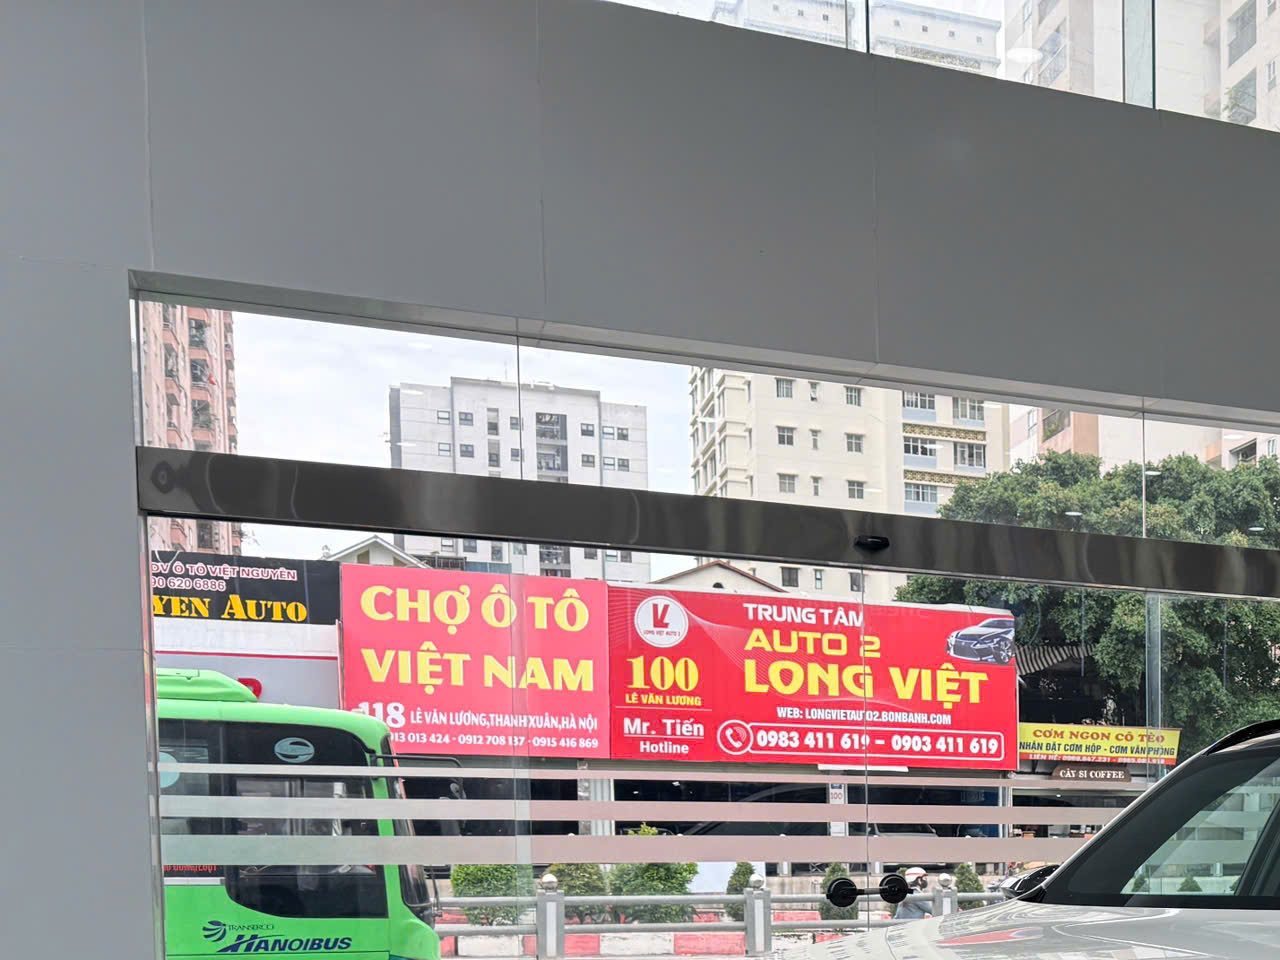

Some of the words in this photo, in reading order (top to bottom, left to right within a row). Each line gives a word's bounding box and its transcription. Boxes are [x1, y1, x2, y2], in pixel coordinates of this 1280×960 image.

[187, 562, 207, 577] TÔ
[207, 564, 239, 579] VIỆT
[167, 577, 194, 590] 620
[194, 579, 226, 591] 6886
[360, 585, 470, 635] CHỢ
[481, 583, 517, 628] Ô
[527, 588, 589, 632] TÔ
[743, 603, 816, 624] TRUNG
[819, 606, 864, 627] TÂM
[743, 628, 848, 656] AUTO
[859, 635, 881, 659] 2
[360, 641, 471, 695] VIỆT
[483, 655, 594, 692] NAM
[626, 655, 699, 691] 100
[744, 658, 874, 699] LONG
[888, 663, 989, 709] VIỆT
[625, 693, 638, 704] LÊ
[641, 693, 663, 705] VĂN
[410, 707, 422, 724] LÊ
[424, 708, 448, 724] VĂN
[579, 714, 597, 733] NỘI
[776, 706, 803, 719] WEB:
[623, 717, 656, 735] Mr.
[662, 717, 704, 736] Tiến
[1032, 729, 1064, 739] CƠM
[1069, 731, 1111, 741] NGON
[408, 732, 426, 743] 013
[429, 733, 450, 743] 424
[458, 734, 484, 744] 0912
[486, 735, 506, 745] 708
[533, 736, 557, 747] 0915
[559, 737, 577, 748] 416
[579, 738, 598, 748] 869
[640, 741, 689, 754] Hotline
[756, 730, 799, 748] 0983
[804, 732, 834, 749] 411
[840, 733, 870, 750] 619
[891, 734, 932, 751] 0903
[935, 736, 964, 753] 411
[969, 737, 998, 754] 619
[1063, 742, 1082, 753] CƠM
[1109, 744, 1128, 754] CƠM
[1090, 771, 1124, 779] COFFEE
